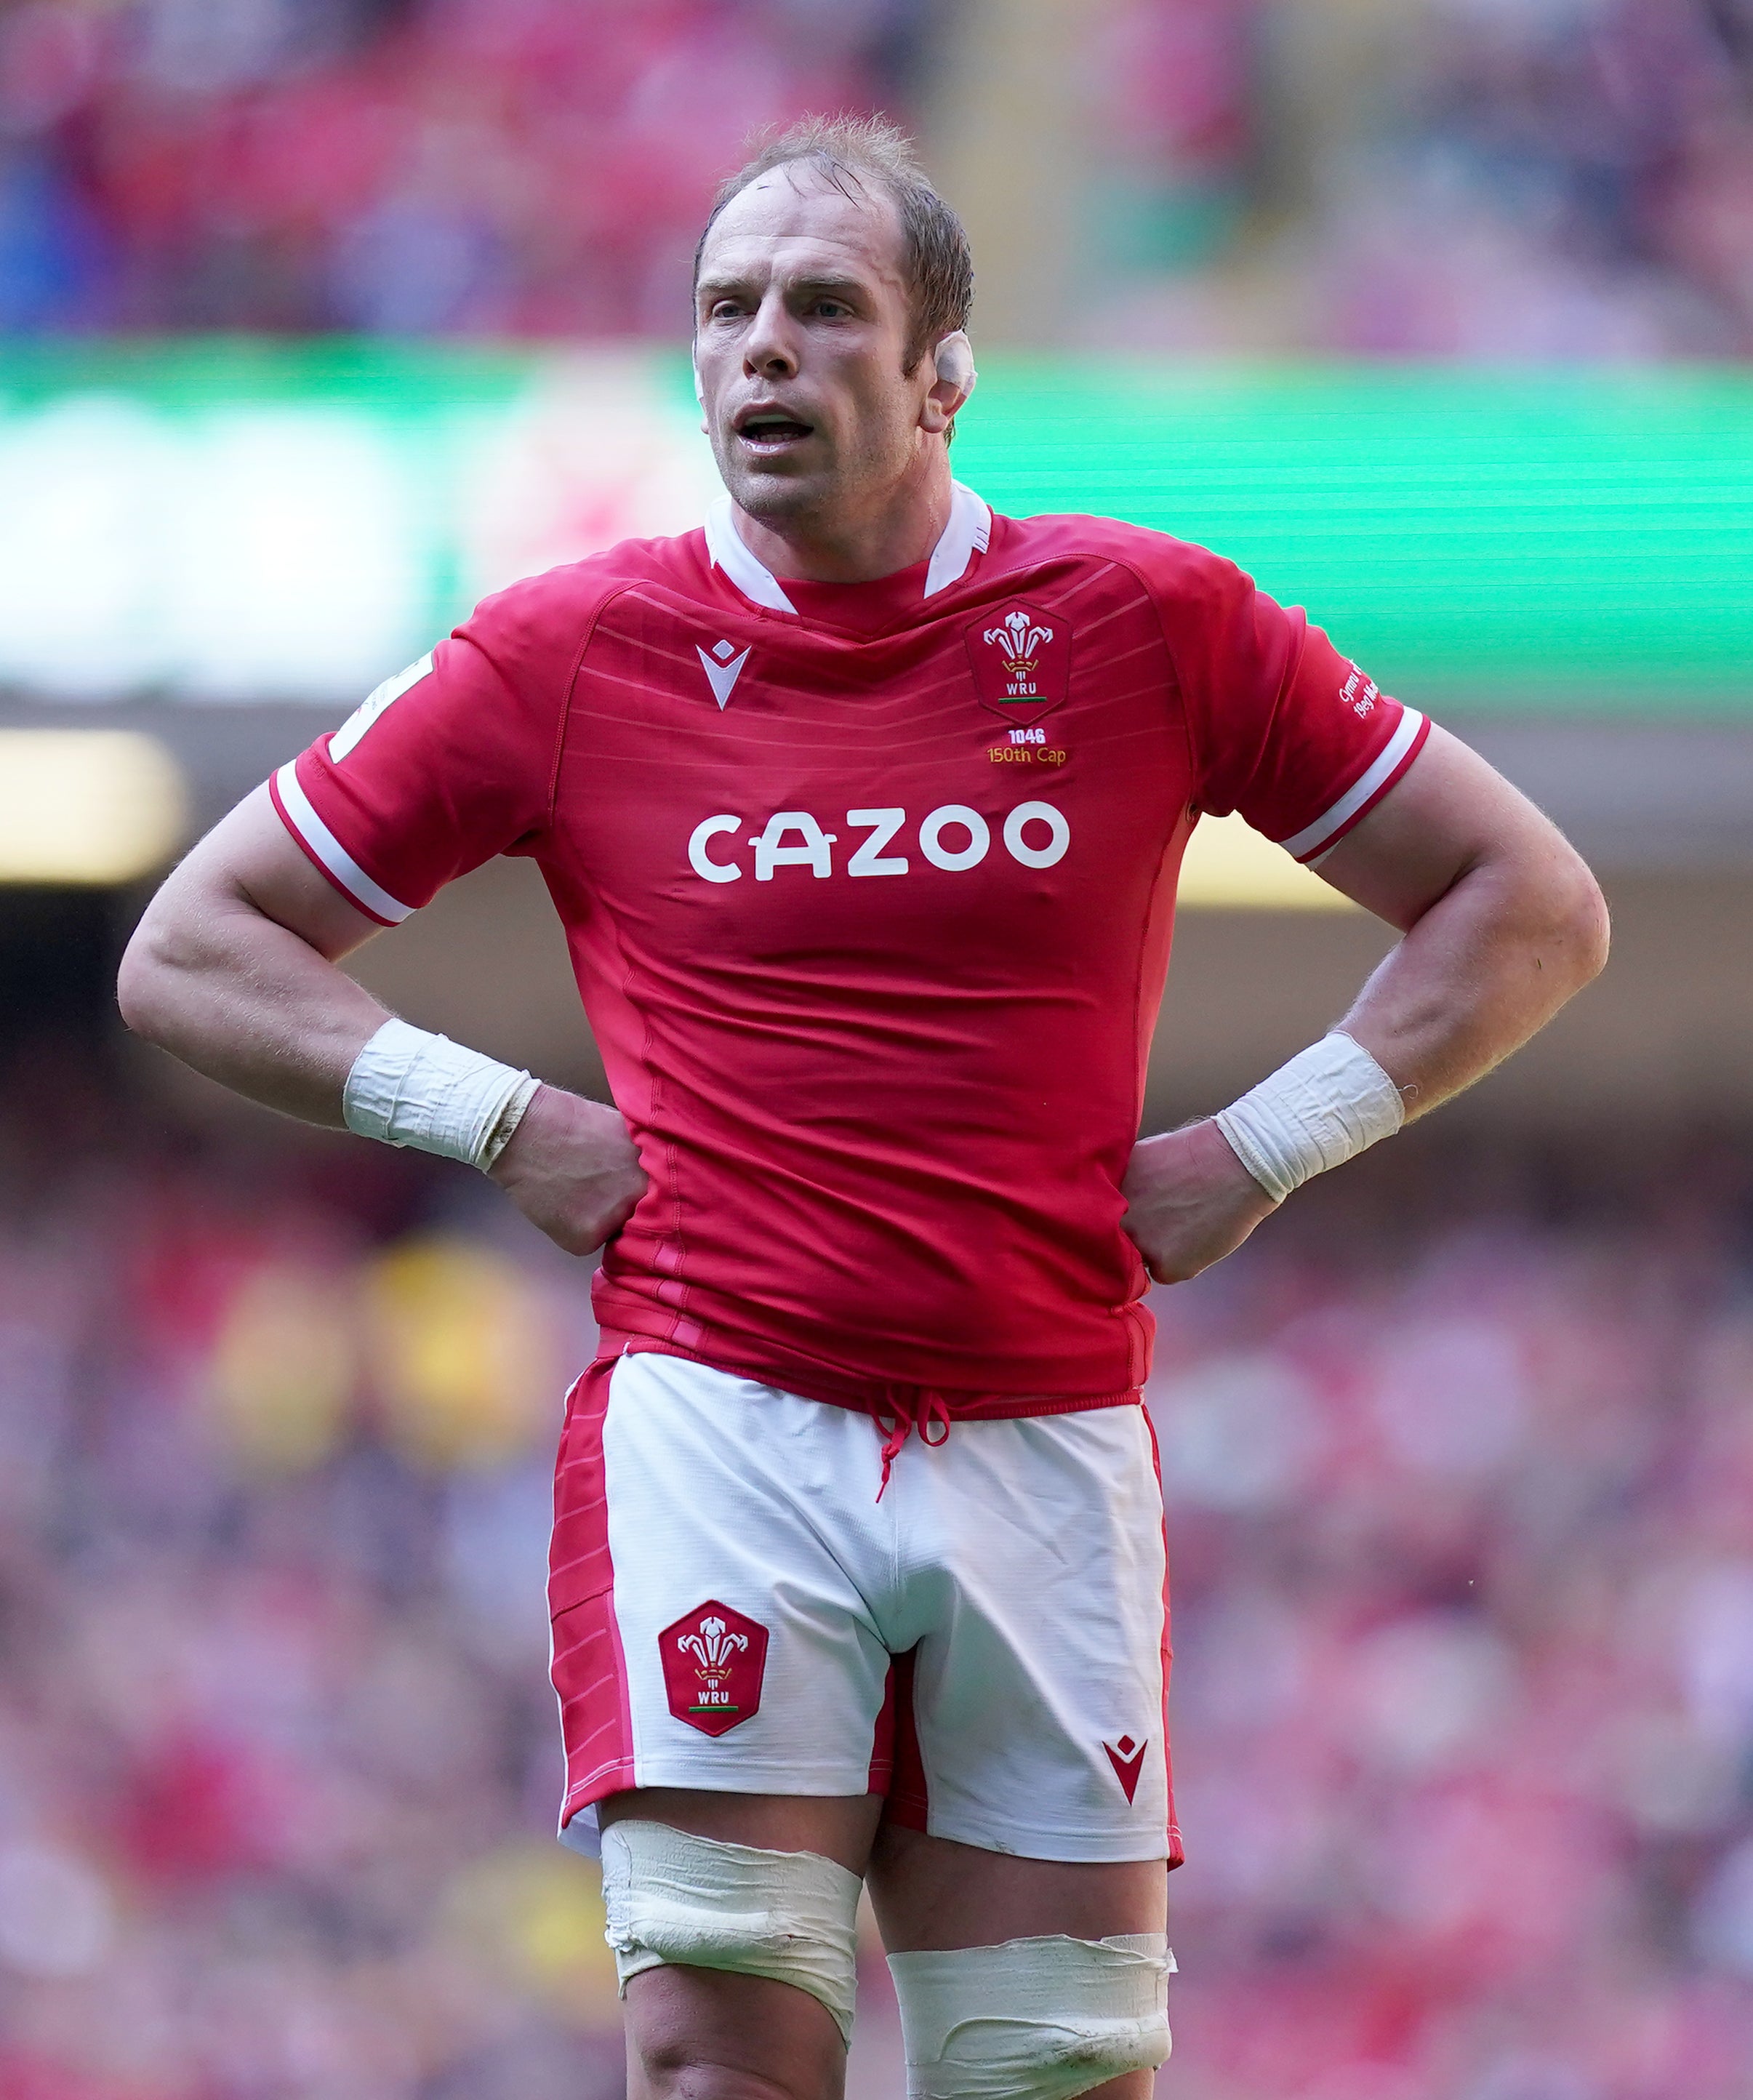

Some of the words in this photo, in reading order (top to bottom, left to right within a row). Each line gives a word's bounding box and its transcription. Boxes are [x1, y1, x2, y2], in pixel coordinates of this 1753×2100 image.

[1006, 682, 1037, 695] WRU
[1008, 728, 1046, 745] 1046
[987, 747, 1032, 763] 150th
[1037, 747, 1067, 766] Cap
[687, 800, 1071, 883] CAZOO
[697, 1691, 730, 1704] WRU
